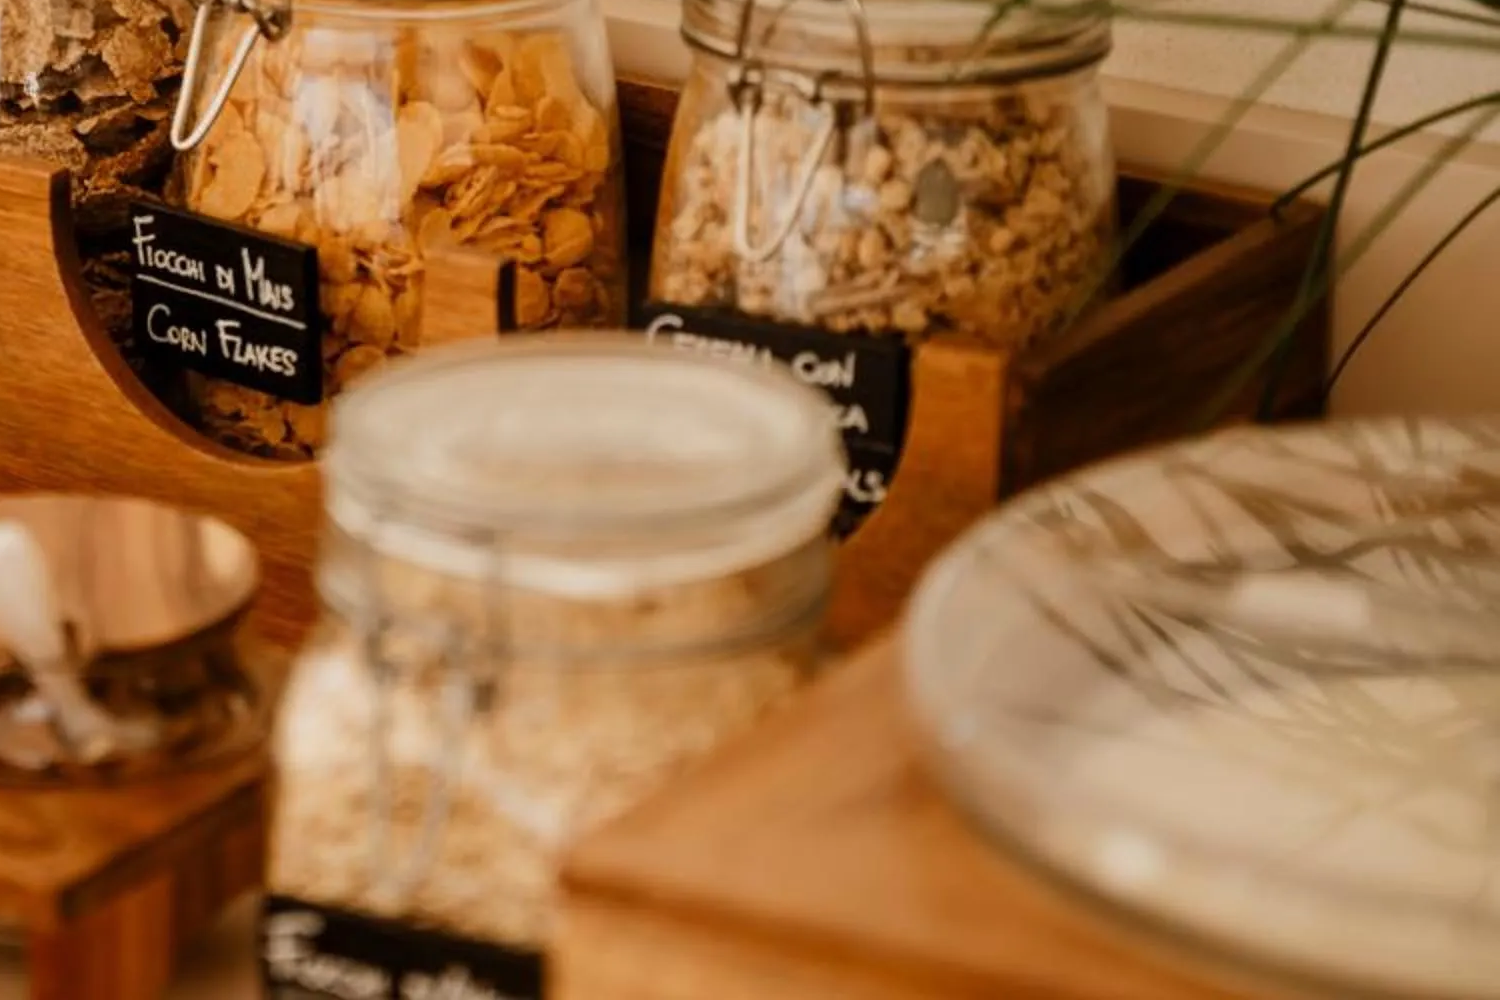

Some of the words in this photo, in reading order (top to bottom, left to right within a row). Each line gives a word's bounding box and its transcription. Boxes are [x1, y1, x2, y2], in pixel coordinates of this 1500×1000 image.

[241, 247, 294, 311] MAIS
[147, 303, 207, 355] CORN
[215, 319, 298, 377] FLAKES
